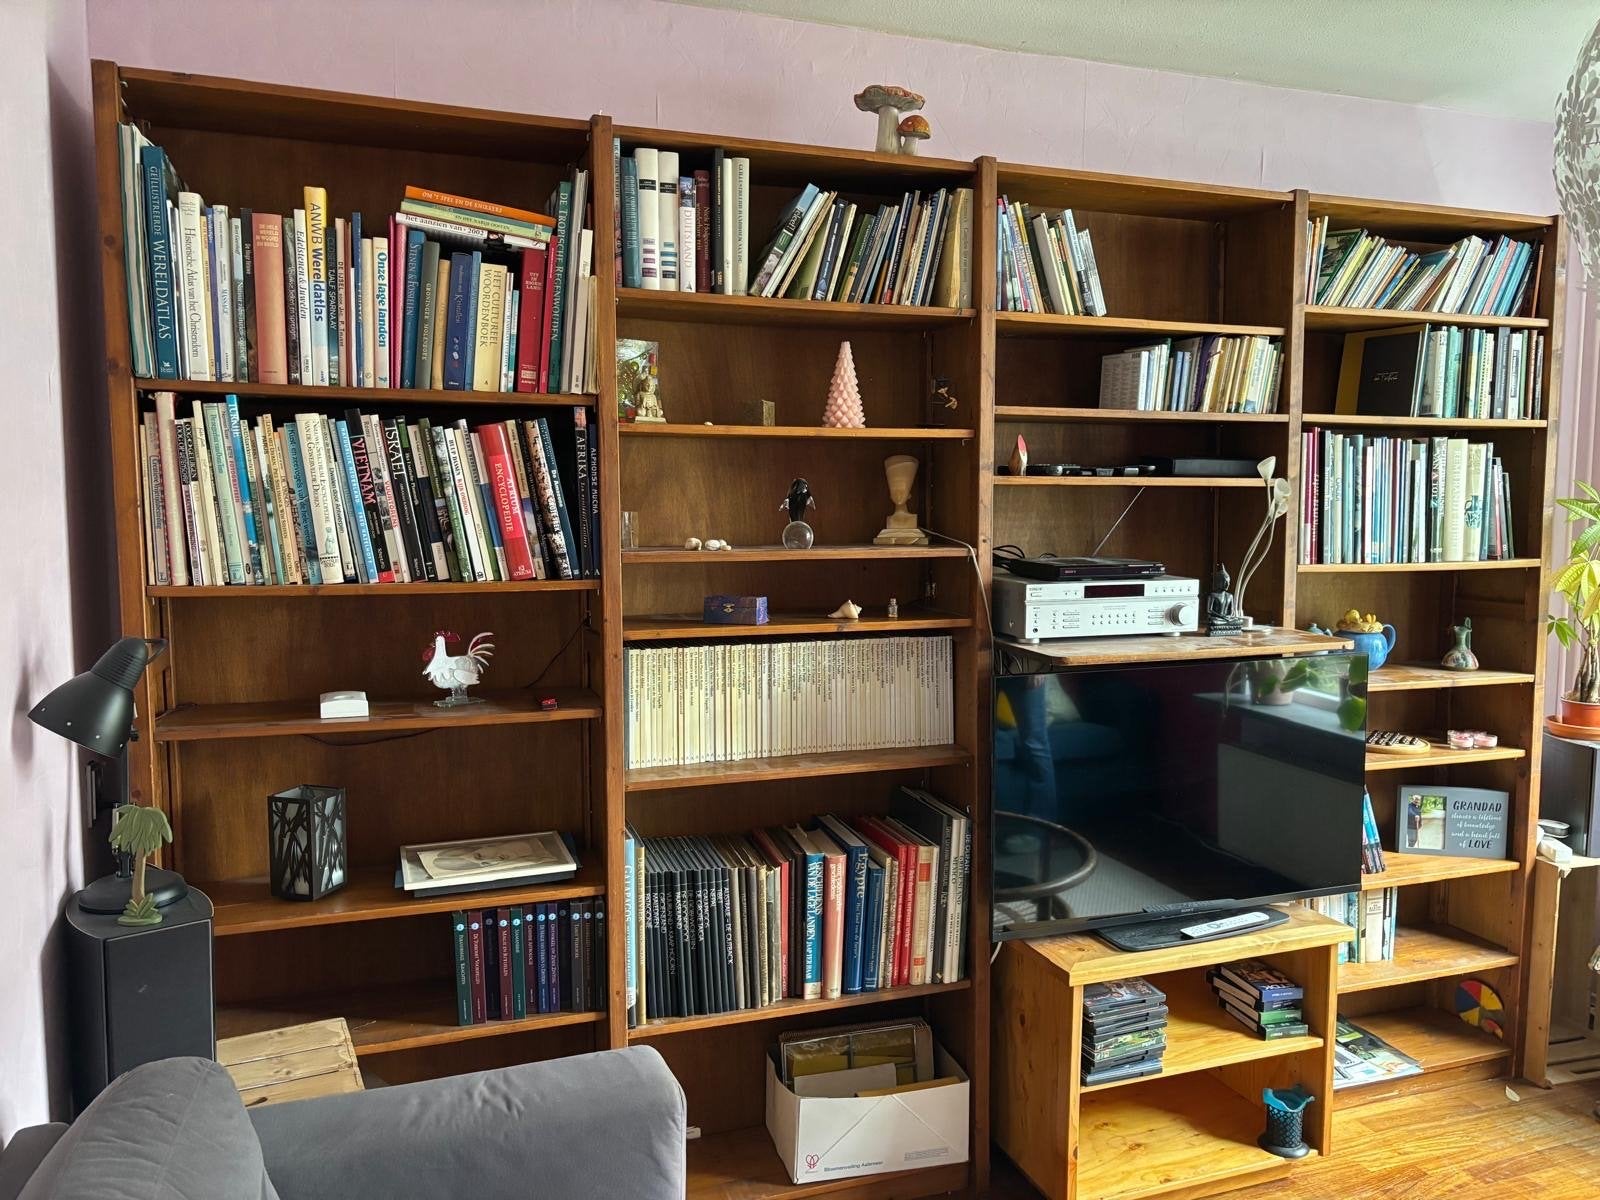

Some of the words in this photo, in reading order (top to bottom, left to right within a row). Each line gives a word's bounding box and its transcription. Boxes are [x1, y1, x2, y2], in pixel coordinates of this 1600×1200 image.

[150, 166, 163, 236] GEÏLLUSTREERDE
[422, 191, 432, 199] OM
[560, 192, 568, 205] DE
[310, 202, 323, 244] ANWB
[405, 214, 419, 222] het
[420, 217, 448, 229] aanzien
[450, 224, 462, 232] van
[467, 227, 484, 236] 2002
[556, 210, 568, 263] TROPISCHE
[683, 209, 692, 268] DUITSLAND
[184, 227, 198, 267] Historische
[296, 231, 305, 276] Edelstenen
[187, 269, 199, 287] Atlas
[328, 269, 336, 289] TJALF
[377, 252, 387, 281] Onze
[492, 270, 502, 289] HET
[153, 240, 171, 339] WERELDATLAS
[188, 288, 197, 300] van
[312, 248, 325, 322] Wereldatlas
[376, 283, 387, 305] lage
[189, 301, 199, 312] het
[298, 285, 307, 319] Juwelen
[329, 291, 337, 330] SPARNAAY
[479, 269, 492, 348] WOORDENBOEK
[551, 265, 564, 341] REGENWOUDEN
[189, 313, 202, 358] Christendom
[378, 308, 387, 347] landen
[489, 292, 501, 346] CULTUREEL
[228, 402, 239, 438] TURKIJE
[340, 427, 351, 464] NATUURLIJK
[347, 466, 360, 503] NEDERLAND
[385, 426, 404, 480] ISRAEL
[576, 436, 587, 479] AFRIKA
[290, 455, 304, 488] zeevogels
[351, 438, 376, 505] VIETNAM
[551, 469, 557, 479] De
[300, 501, 307, 510] de
[331, 489, 339, 503] door
[385, 480, 399, 529] VUURTORENS
[494, 463, 513, 532] ENCYCLOPEDIE
[506, 478, 519, 514] ATRIUM
[553, 480, 564, 508] Amazone
[300, 510, 309, 524] hele
[334, 503, 345, 534] Antwerpen
[302, 524, 312, 546] wereld
[1453, 801, 1502, 812] GRANDAD
[1468, 840, 1493, 849] LOVE
[807, 862, 815, 878] VAN
[807, 879, 815, 890] DE
[855, 853, 868, 899] Egypte
[709, 888, 717, 907] NEPAL
[807, 891, 815, 909] LAGE
[815, 861, 823, 915] GESCHIEDENIS
[702, 889, 710, 928] GALAPAGOS
[806, 910, 815, 940] LANDEN
[726, 924, 732, 933] DE
